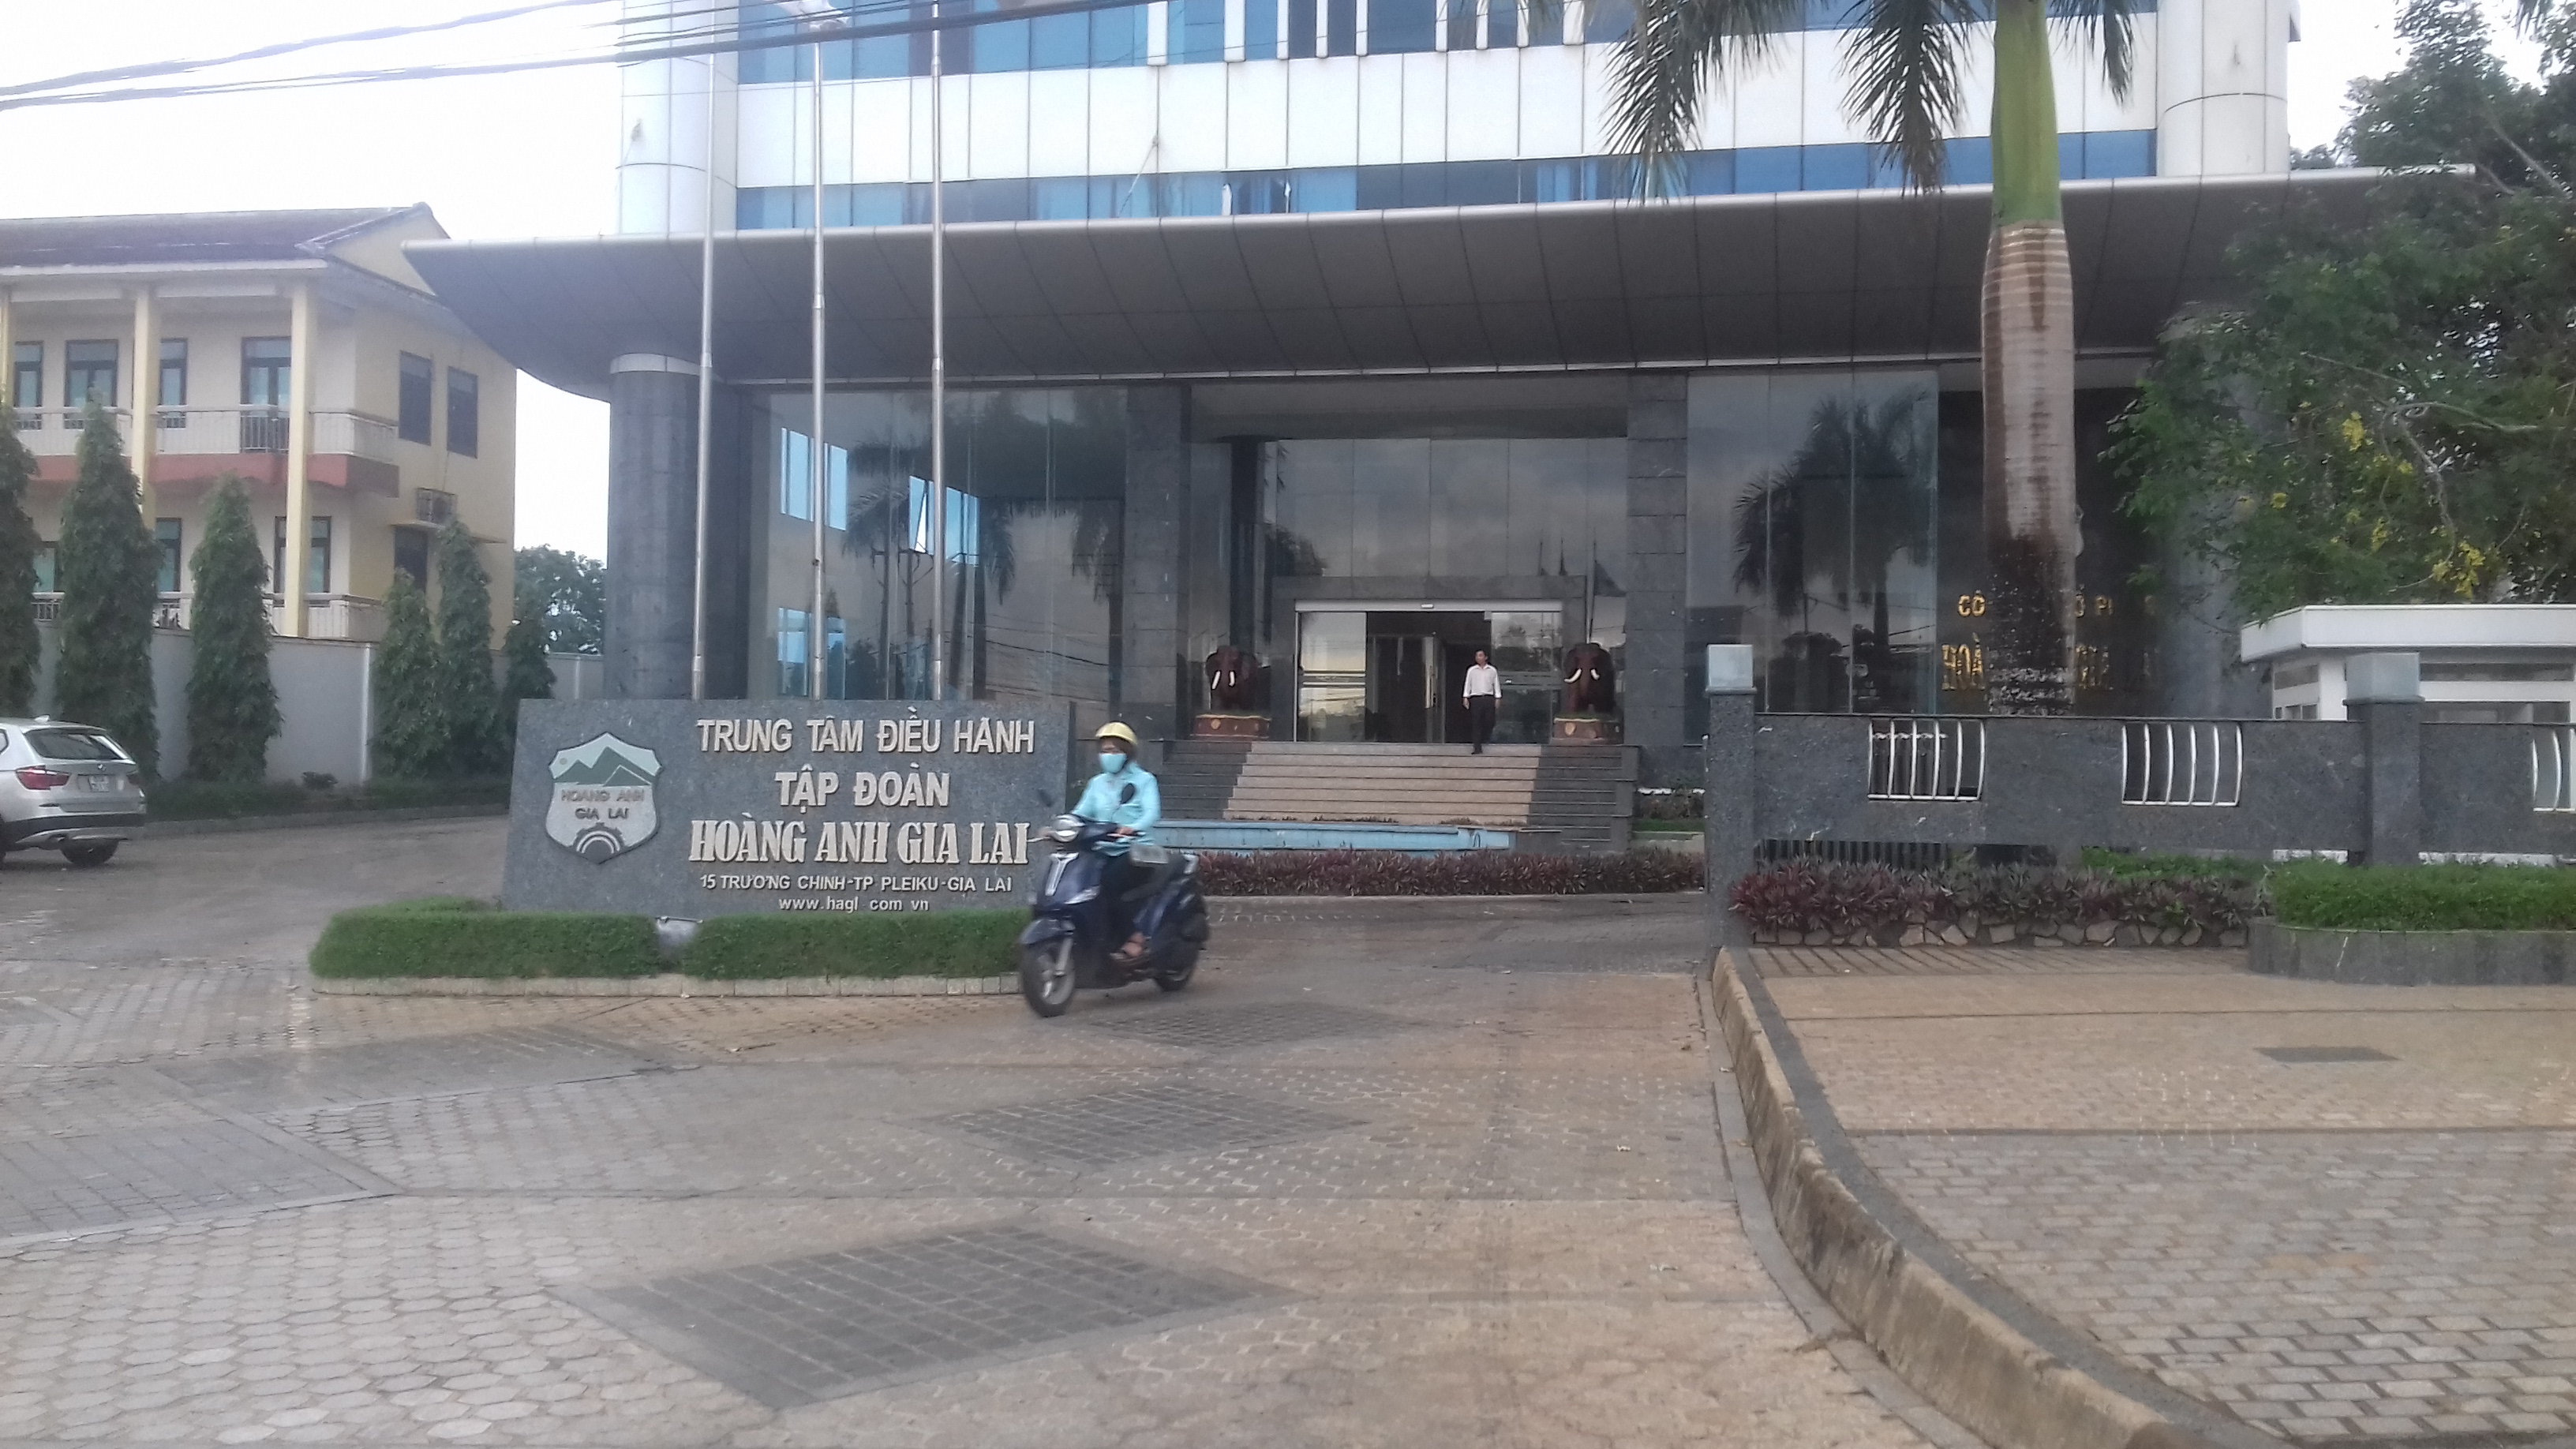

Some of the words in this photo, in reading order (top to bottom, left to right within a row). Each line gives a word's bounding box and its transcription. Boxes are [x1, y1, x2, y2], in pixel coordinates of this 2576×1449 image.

[695, 717, 793, 752] TRUNG
[806, 714, 864, 752] TÂM
[874, 705, 942, 753] ĐIỀU
[774, 762, 839, 814] TẬP
[852, 761, 950, 807] ĐOÀN
[575, 807, 600, 820] GIA
[608, 807, 630, 819] LAI
[688, 811, 807, 863] HOÀNG
[814, 821, 891, 863] ANH
[897, 822, 960, 865] GIA
[968, 822, 1031, 865] LAI
[699, 874, 717, 889] 15
[985, 876, 1013, 893] LAI
